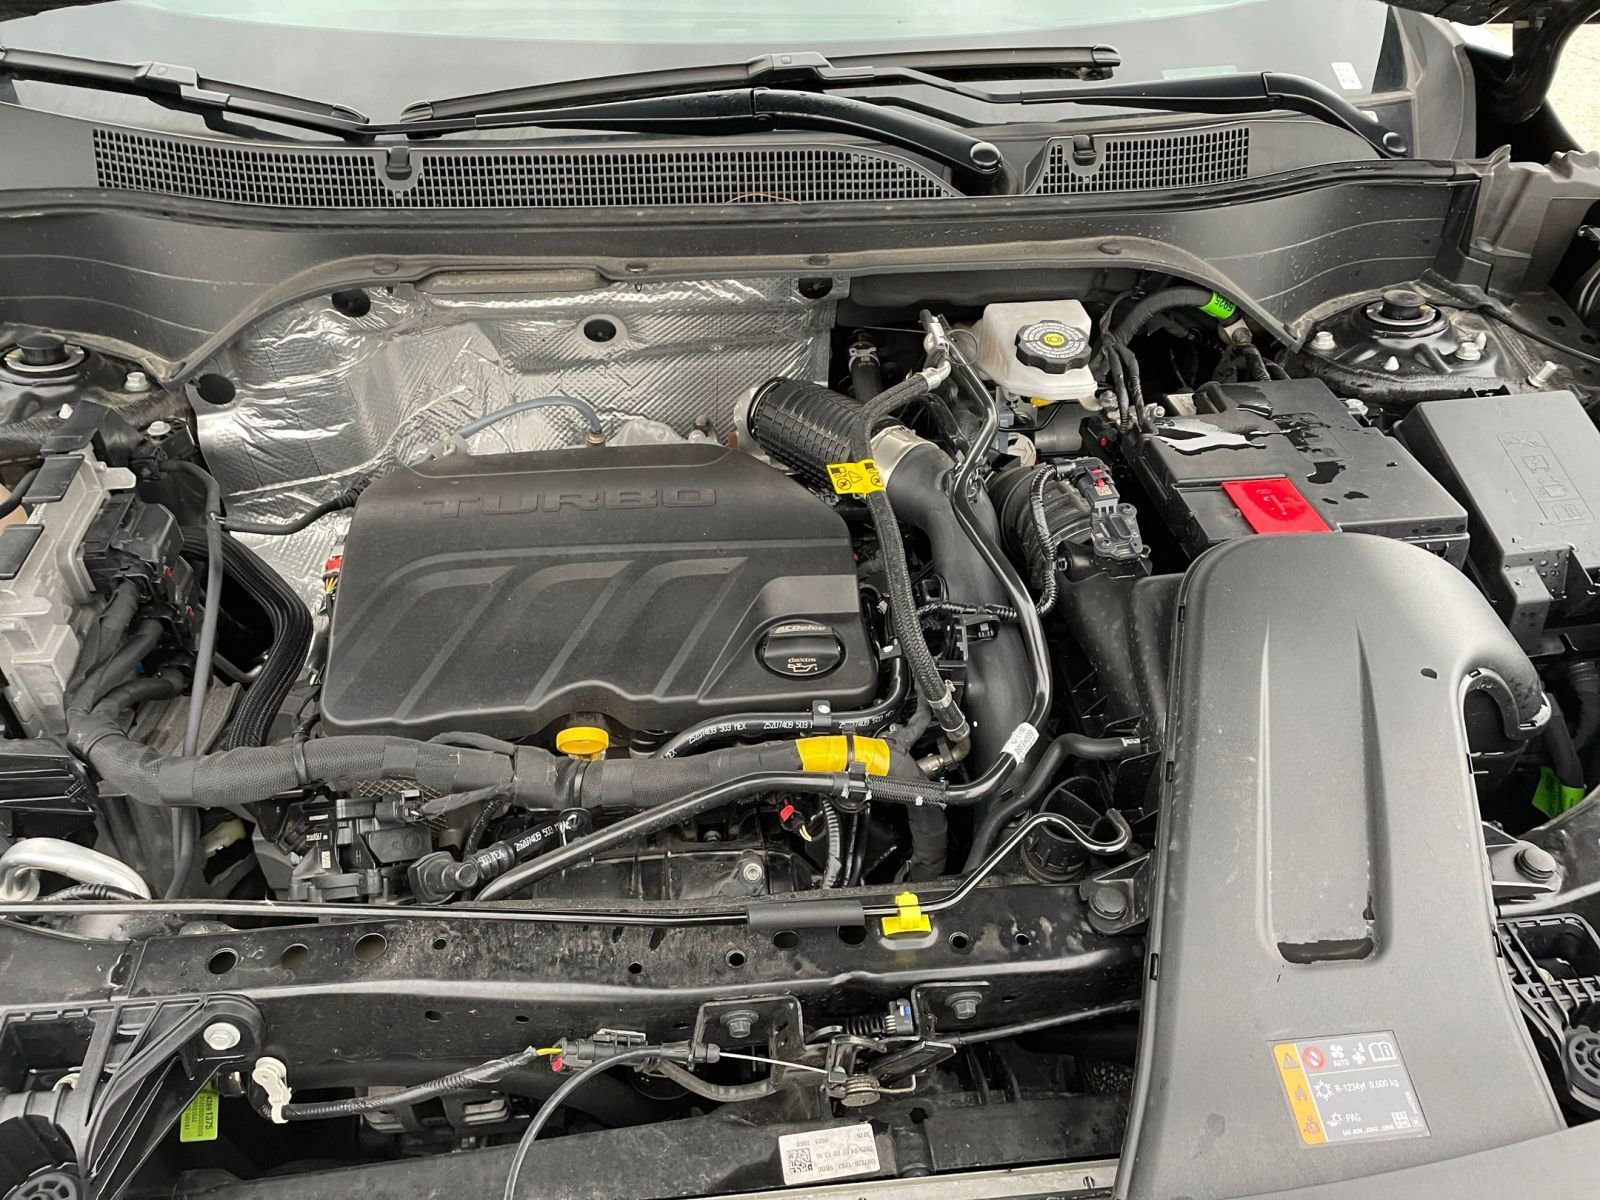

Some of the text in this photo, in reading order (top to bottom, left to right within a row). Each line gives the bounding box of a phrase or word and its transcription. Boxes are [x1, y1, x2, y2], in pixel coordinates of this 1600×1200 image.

[422, 487, 717, 518] TURBO
[1333, 1058, 1350, 1067] AUTO
[1345, 1113, 1362, 1122] PAG
